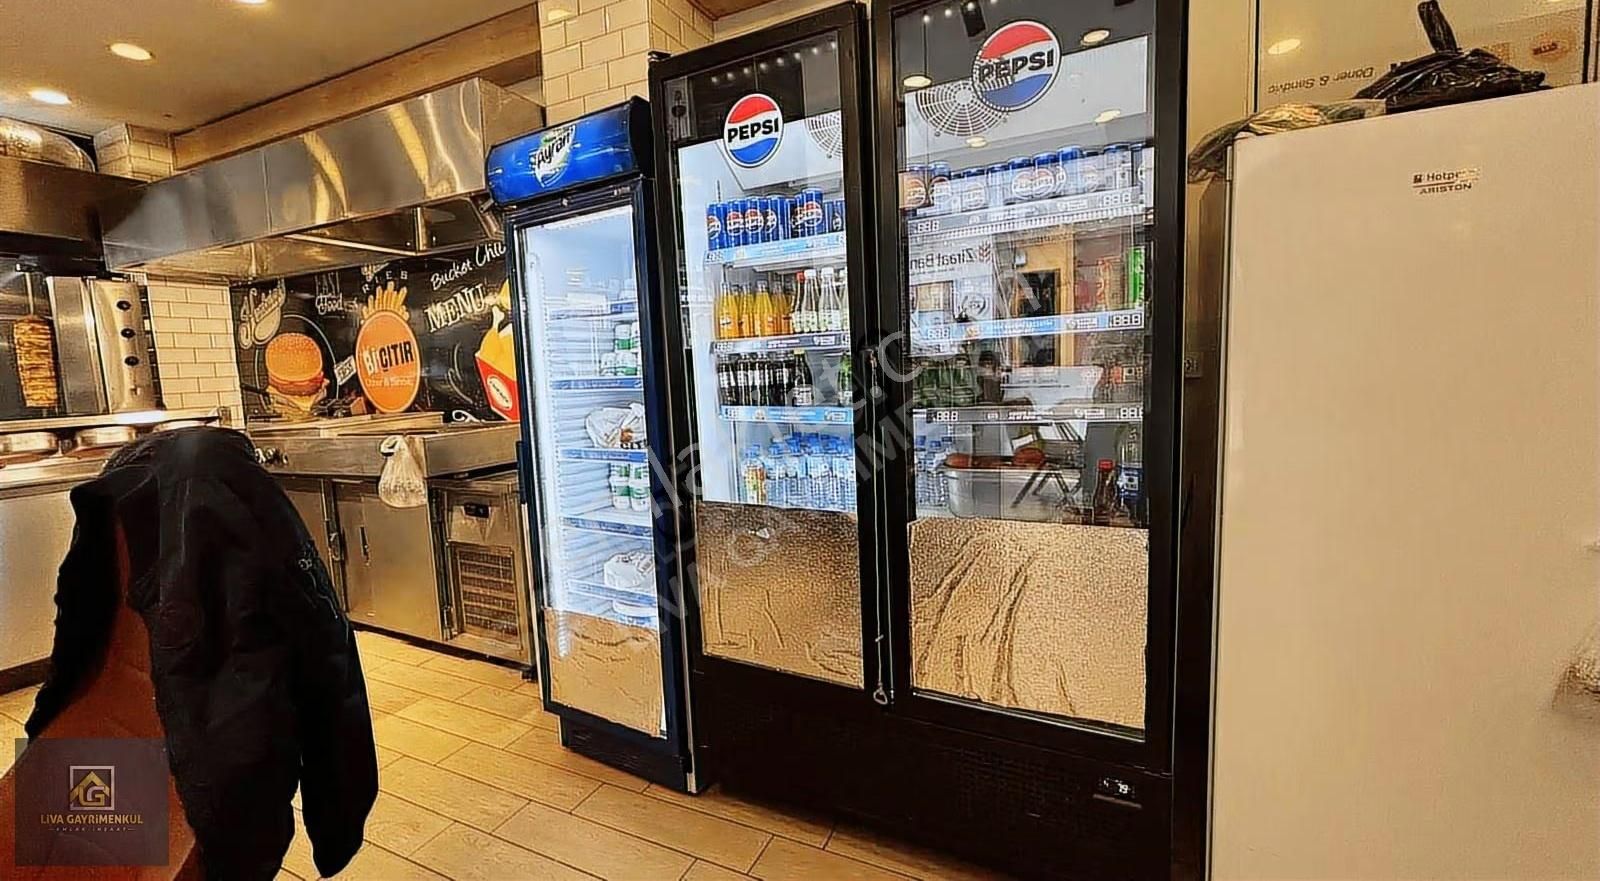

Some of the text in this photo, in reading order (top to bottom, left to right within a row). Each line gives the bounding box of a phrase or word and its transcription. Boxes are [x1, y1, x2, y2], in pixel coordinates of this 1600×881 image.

[979, 48, 1054, 81] PEPSI
[1319, 75, 1330, 86] &
[727, 117, 779, 143] PEPSI
[536, 132, 570, 169] Ayran
[1419, 182, 1473, 195] ARISTON
[424, 283, 485, 333] MENU
